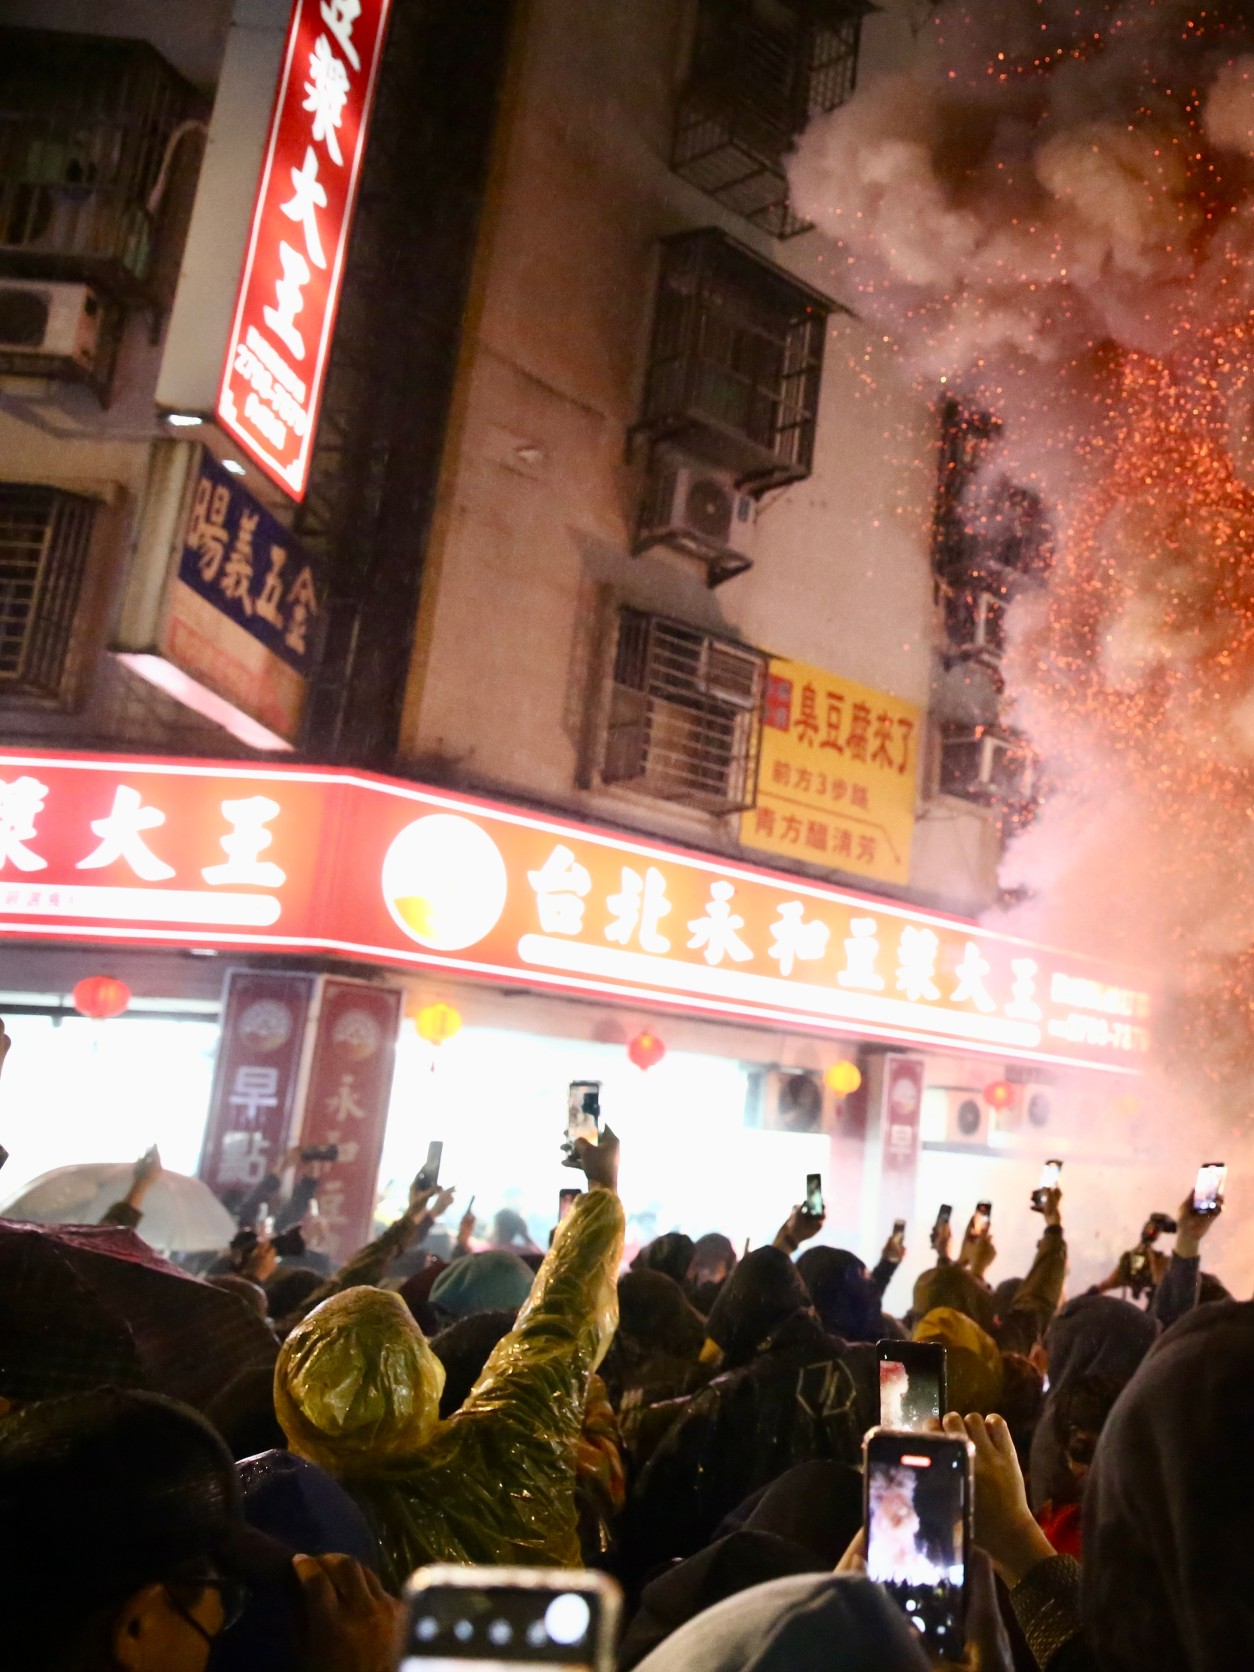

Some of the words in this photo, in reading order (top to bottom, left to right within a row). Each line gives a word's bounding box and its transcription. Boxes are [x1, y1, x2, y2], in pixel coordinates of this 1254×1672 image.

[793, 680, 914, 776] 臭豆腐來了
[527, 845, 1042, 1022] 台北永和豆漿大王
[217, 1065, 280, 1185] 早點
